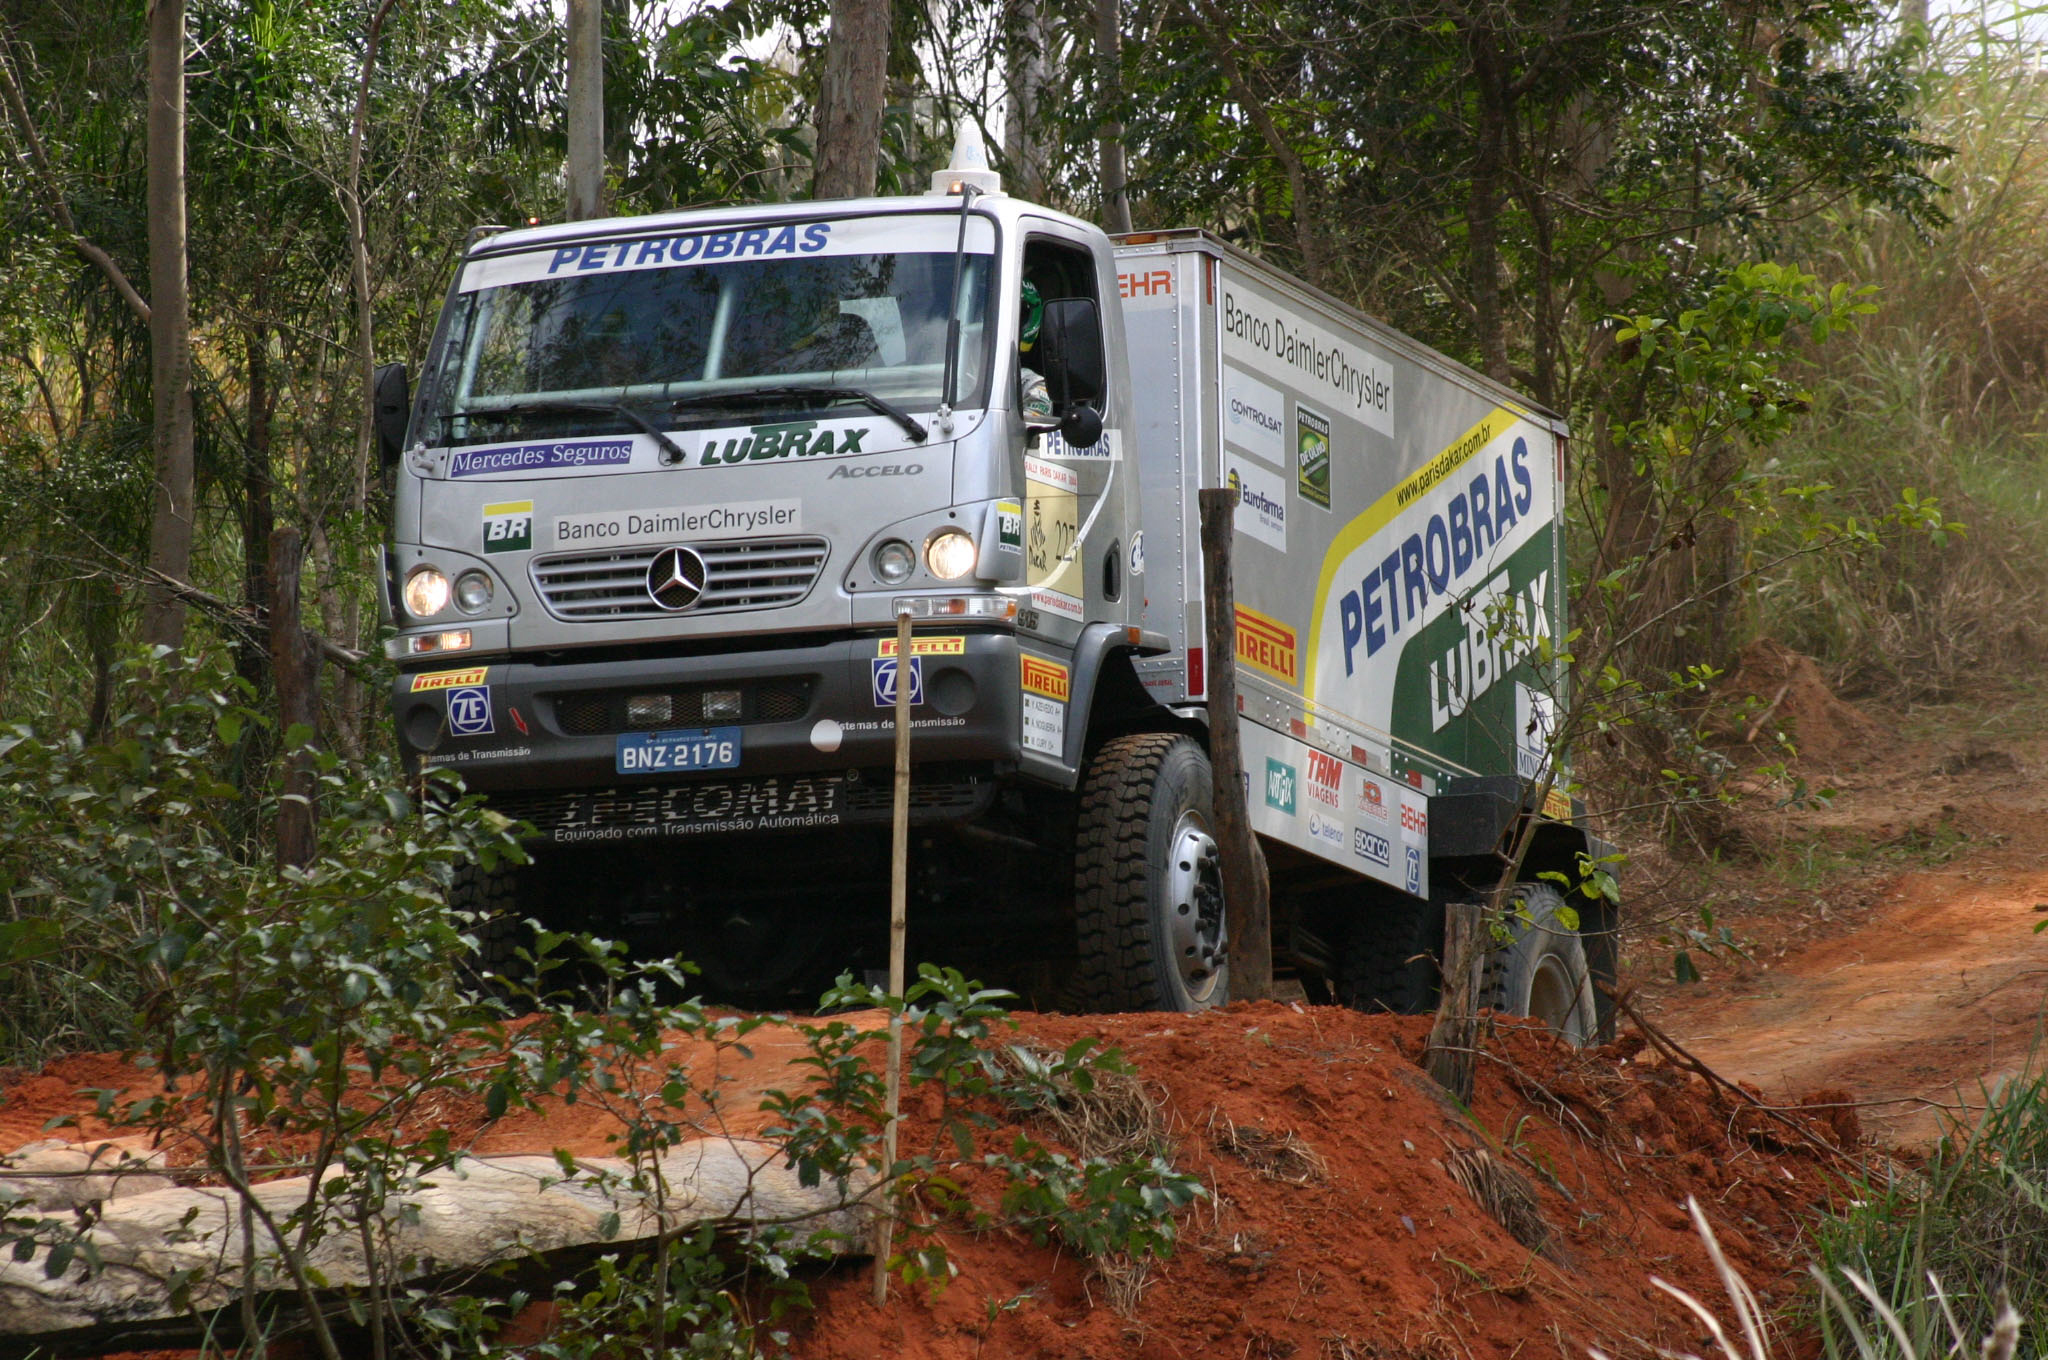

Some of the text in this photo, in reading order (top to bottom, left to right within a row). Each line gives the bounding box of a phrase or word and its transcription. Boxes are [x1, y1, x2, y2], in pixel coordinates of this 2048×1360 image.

[547, 224, 832, 274] PETROBRAS
[1117, 270, 1171, 298] EHR
[1225, 292, 1390, 413] Banco DaimlerChrysler
[1231, 398, 1282, 435] CONTROLSAT
[1298, 410, 1328, 435] PETROBRAS
[453, 442, 632, 474] Mercedes Seguros
[700, 421, 870, 467] LUBRAX
[827, 463, 924, 480] ACCELO
[1396, 424, 1491, 507] www.parisdakar.com.br
[1243, 484, 1284, 521] Eurofarma
[487, 517, 527, 542] BR
[558, 505, 796, 541] Banco DaimlerChrysler
[1002, 515, 1020, 536] BR
[1340, 436, 1533, 679] PETROBRAS
[881, 638, 962, 655] PIELLI
[413, 668, 485, 689] PIRELLI
[1023, 658, 1067, 697] PIRELLI
[453, 697, 485, 725] ZF
[881, 719, 894, 729] de
[908, 717, 965, 728] ansmissão
[458, 751, 470, 762] de
[471, 746, 531, 760] Transmissão
[1307, 748, 1343, 791] TAM
[1307, 782, 1339, 809] VIAGENS
[555, 811, 839, 842] Equipado com Transmissão Automática
[1401, 803, 1427, 837] BEHR
[1355, 829, 1389, 859] sparco
